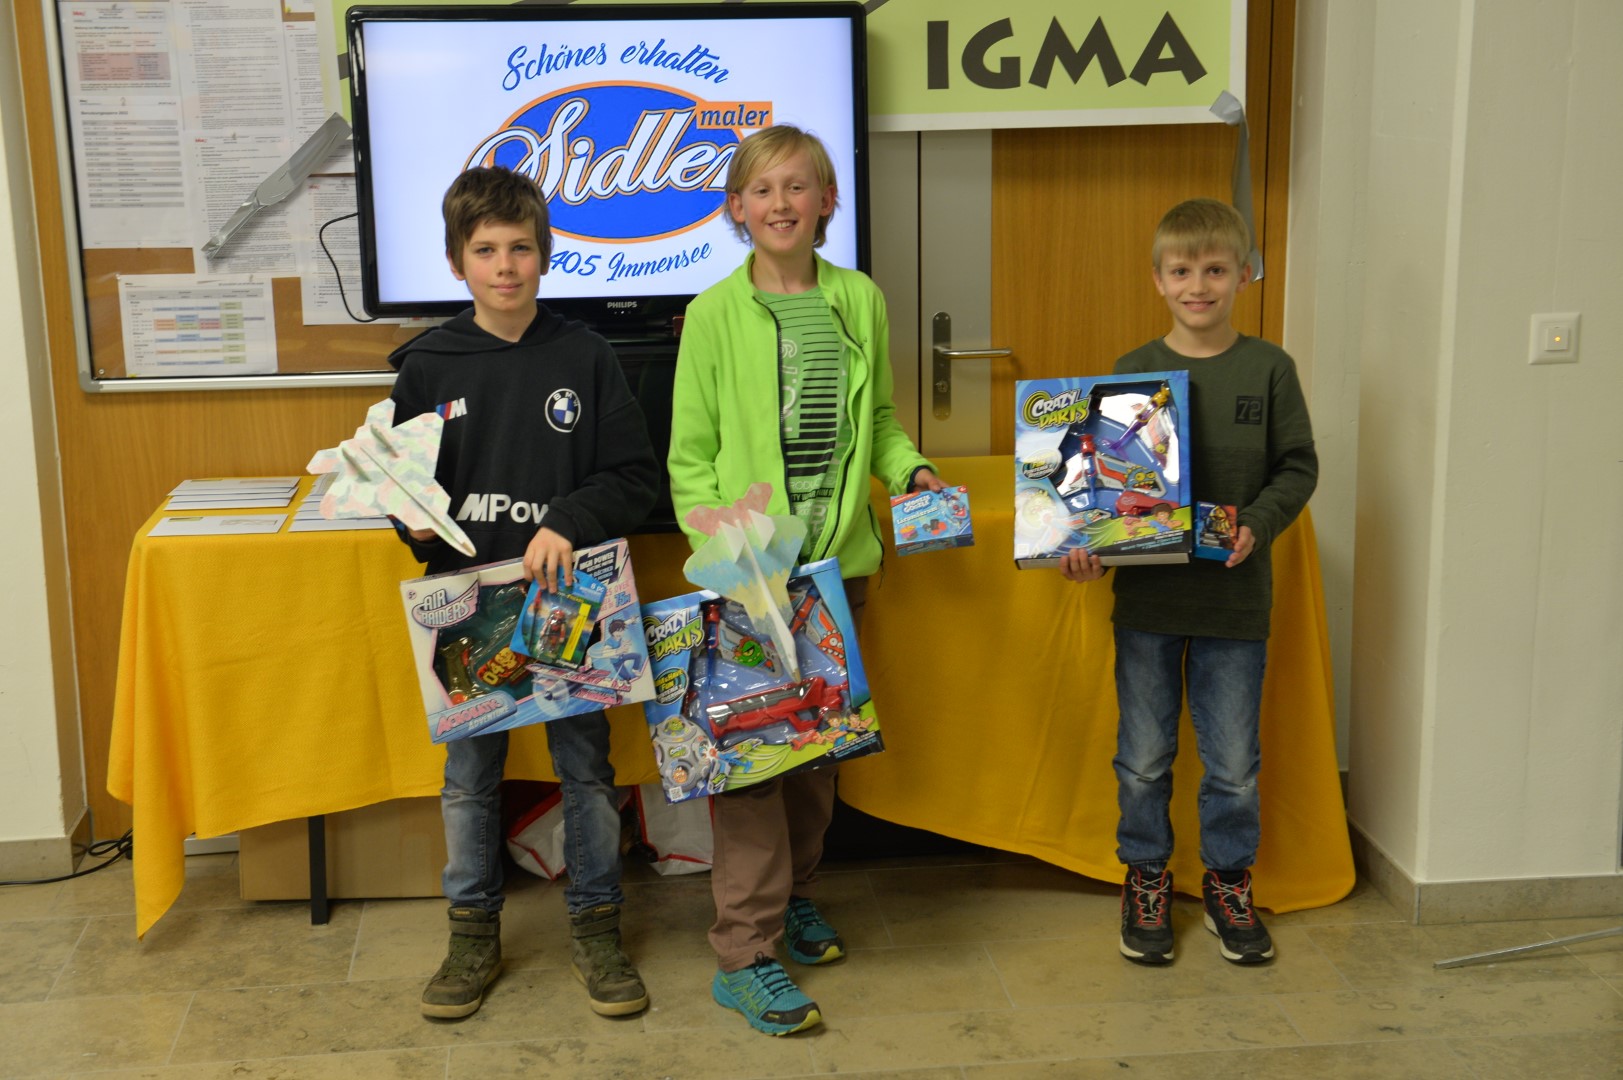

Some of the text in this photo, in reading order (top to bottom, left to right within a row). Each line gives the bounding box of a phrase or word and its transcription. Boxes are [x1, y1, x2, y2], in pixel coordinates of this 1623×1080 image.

[502, 38, 730, 91] Schönes erhalten
[927, 11, 1208, 90] IGMA
[701, 105, 769, 128] maler
[607, 242, 712, 282] Immensee
[607, 301, 638, 309] PHILIPS
[553, 391, 580, 407] BMW
[1032, 389, 1081, 417] CRAZY
[1238, 400, 1261, 420] 72
[1039, 399, 1089, 430] DARTS
[421, 600, 470, 626] RAIDERS
[423, 589, 447, 611] AIR
[645, 607, 700, 646] CRAZY
[655, 621, 704, 660] DARTS
